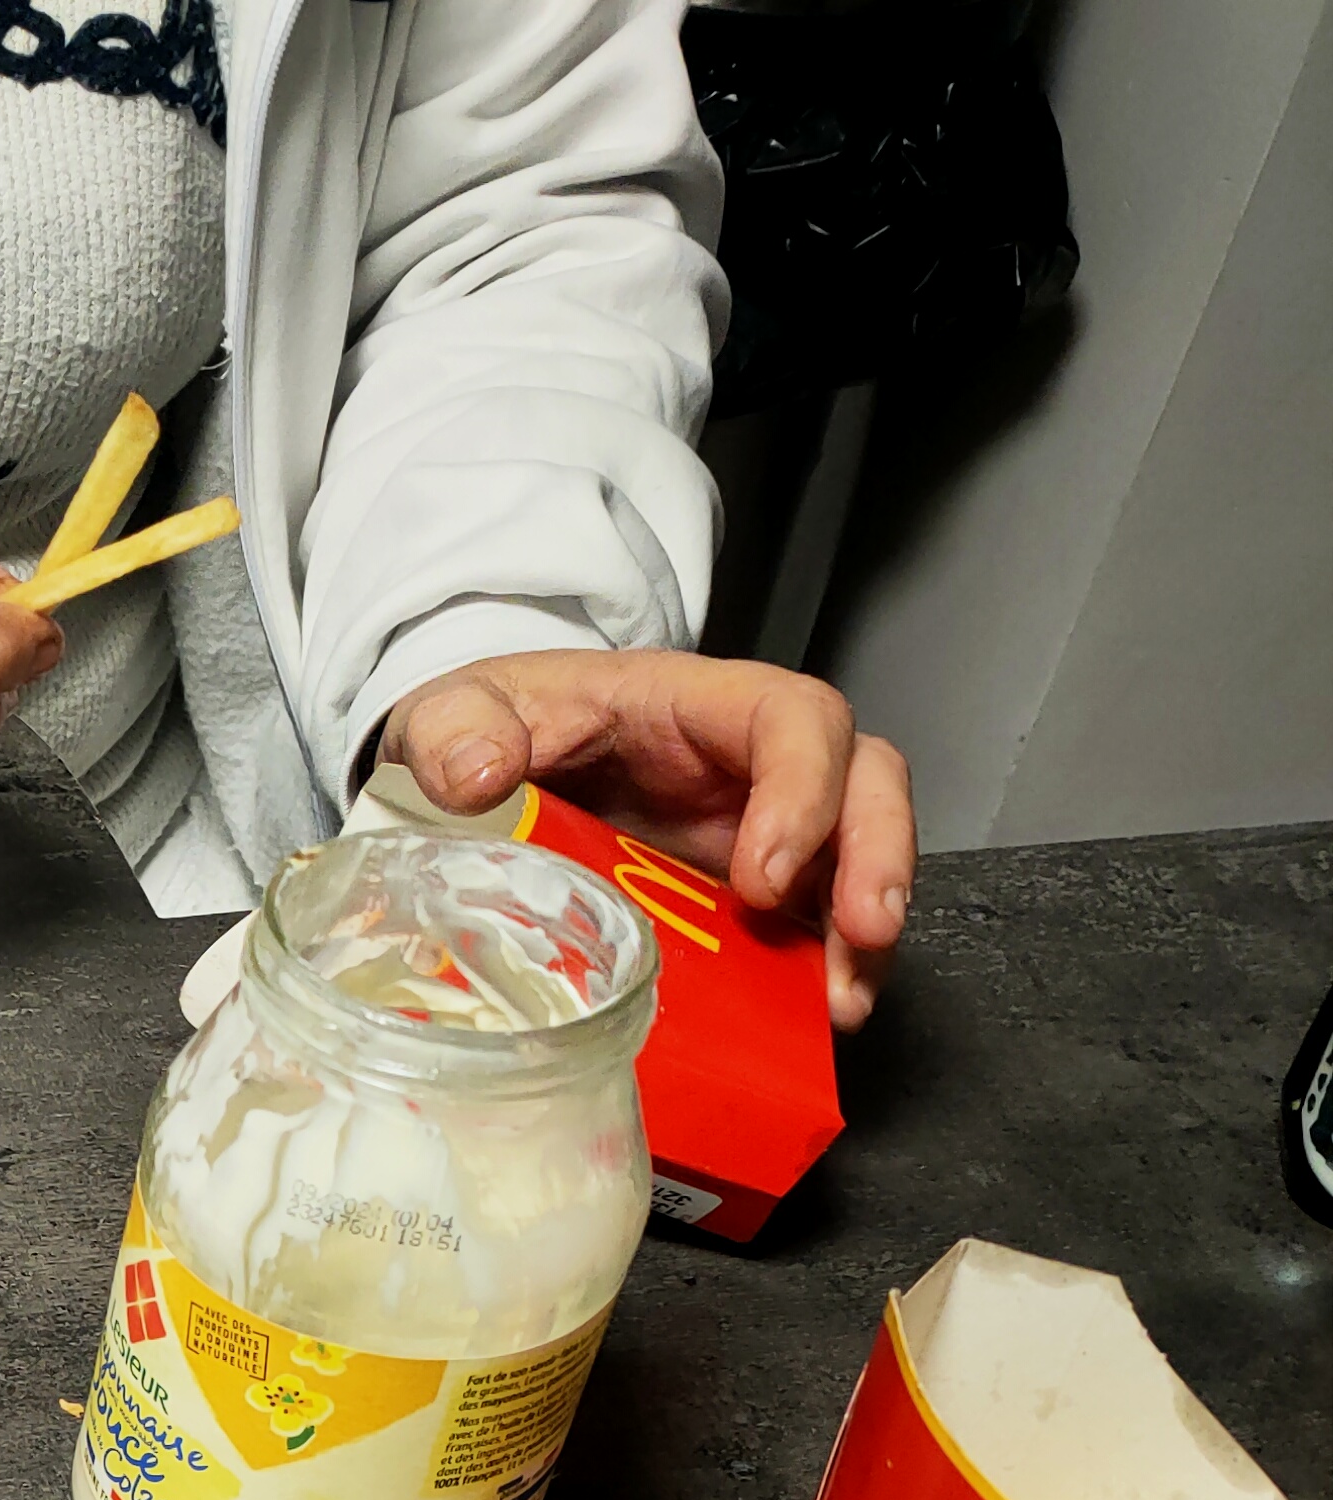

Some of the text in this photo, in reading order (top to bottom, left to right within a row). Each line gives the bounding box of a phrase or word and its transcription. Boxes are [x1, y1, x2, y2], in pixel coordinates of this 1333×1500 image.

[205, 1306, 251, 1334] AVEC DES
[467, 1374, 490, 1386] Fort
[494, 1372, 507, 1383] de
[463, 1388, 477, 1399] de
[458, 1400, 478, 1411] des
[449, 1430, 473, 1441] avec
[476, 1427, 489, 1437] de
[441, 1455, 453, 1465] et
[455, 1452, 474, 1463] des
[437, 1465, 463, 1477] dont
[466, 1461, 483, 1473] des
[434, 1477, 460, 1489] 100%
